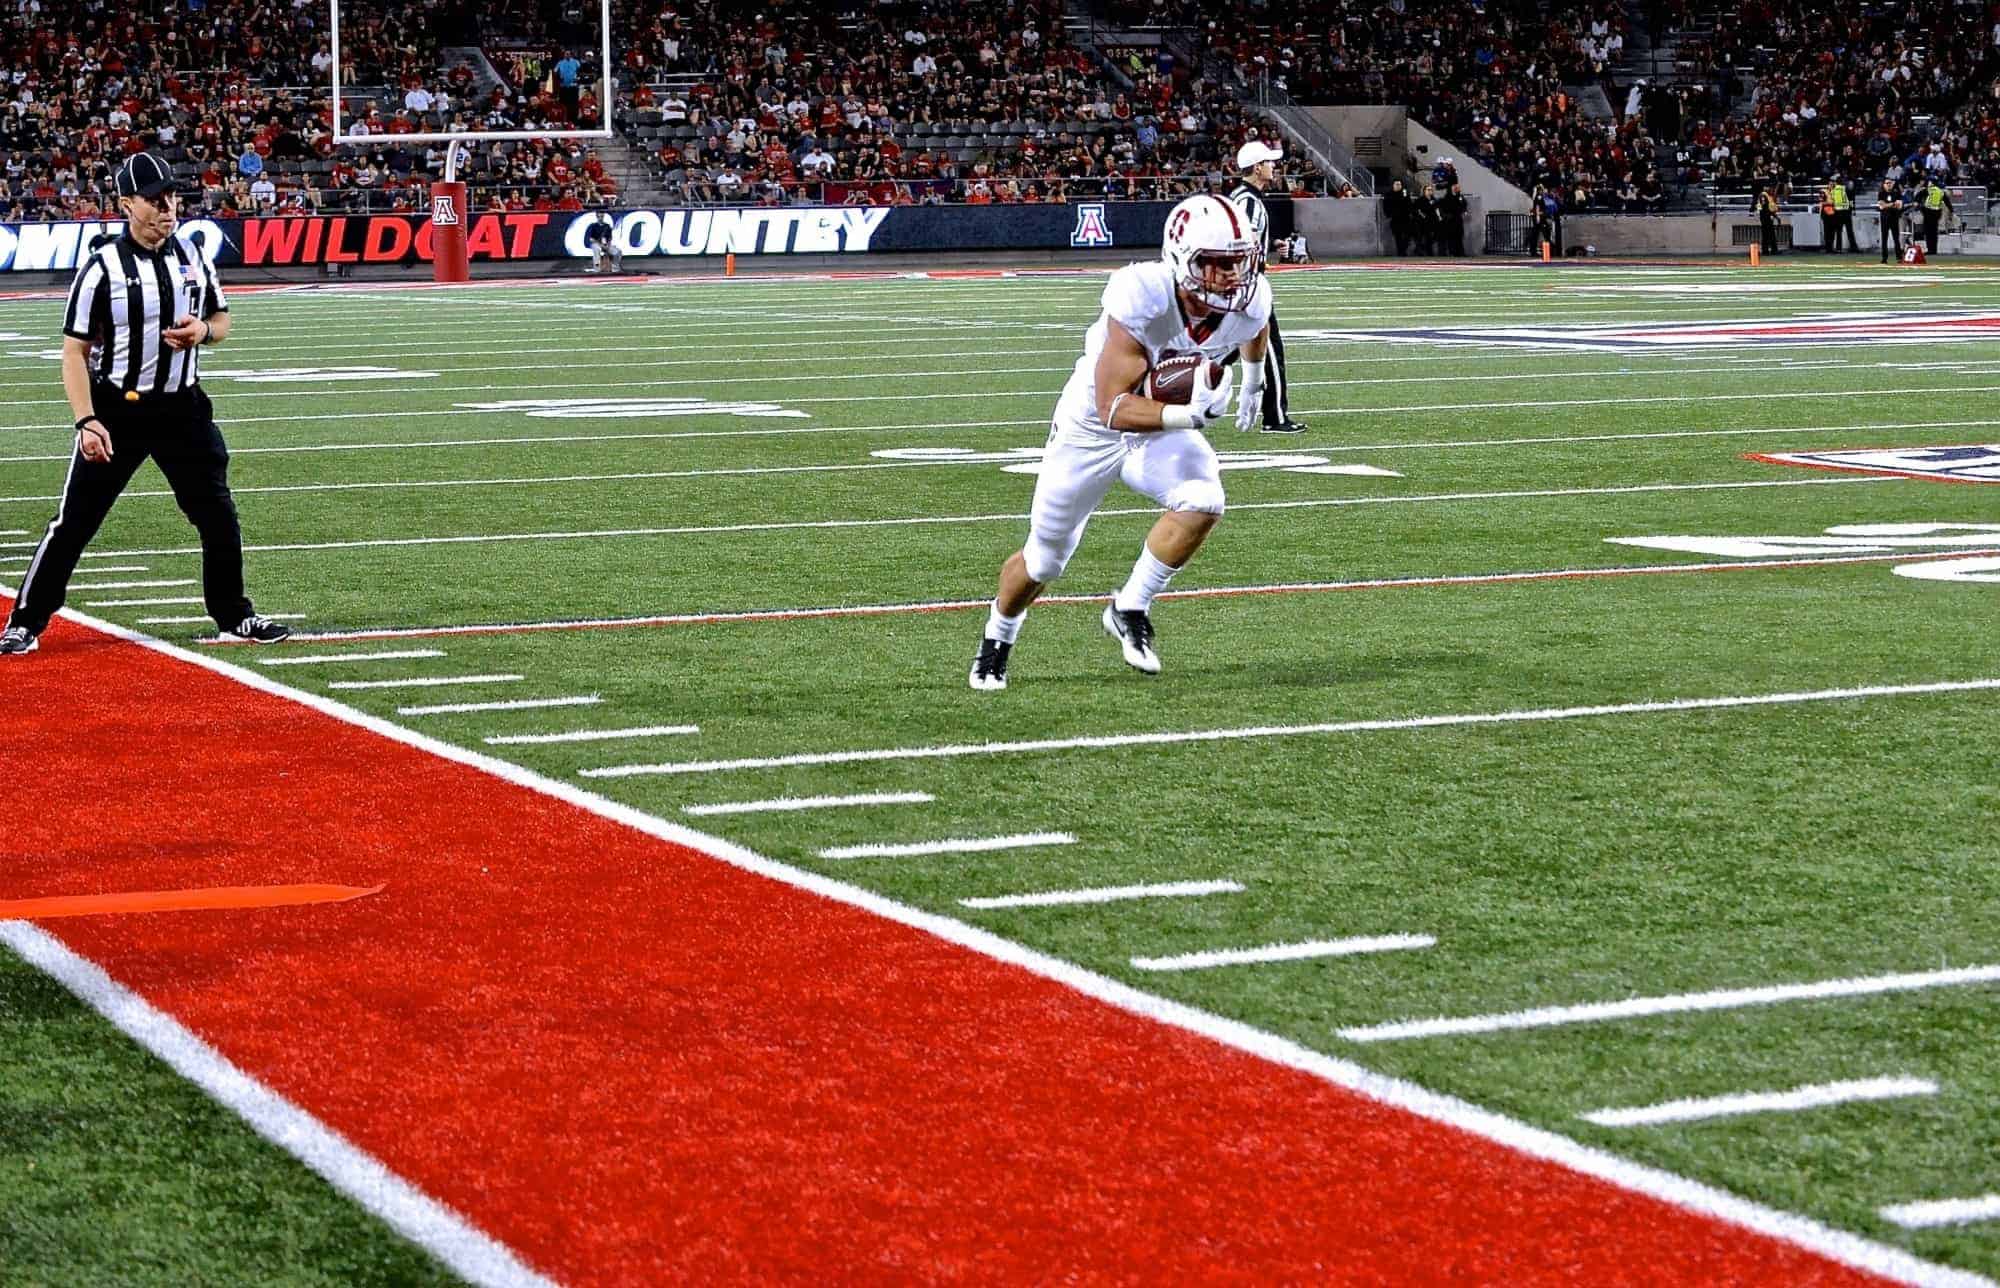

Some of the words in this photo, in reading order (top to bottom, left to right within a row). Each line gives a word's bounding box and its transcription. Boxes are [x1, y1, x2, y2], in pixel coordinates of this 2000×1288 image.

[432, 196, 458, 225] A
[564, 207, 891, 257] COUNTRY
[1070, 203, 1113, 246] A
